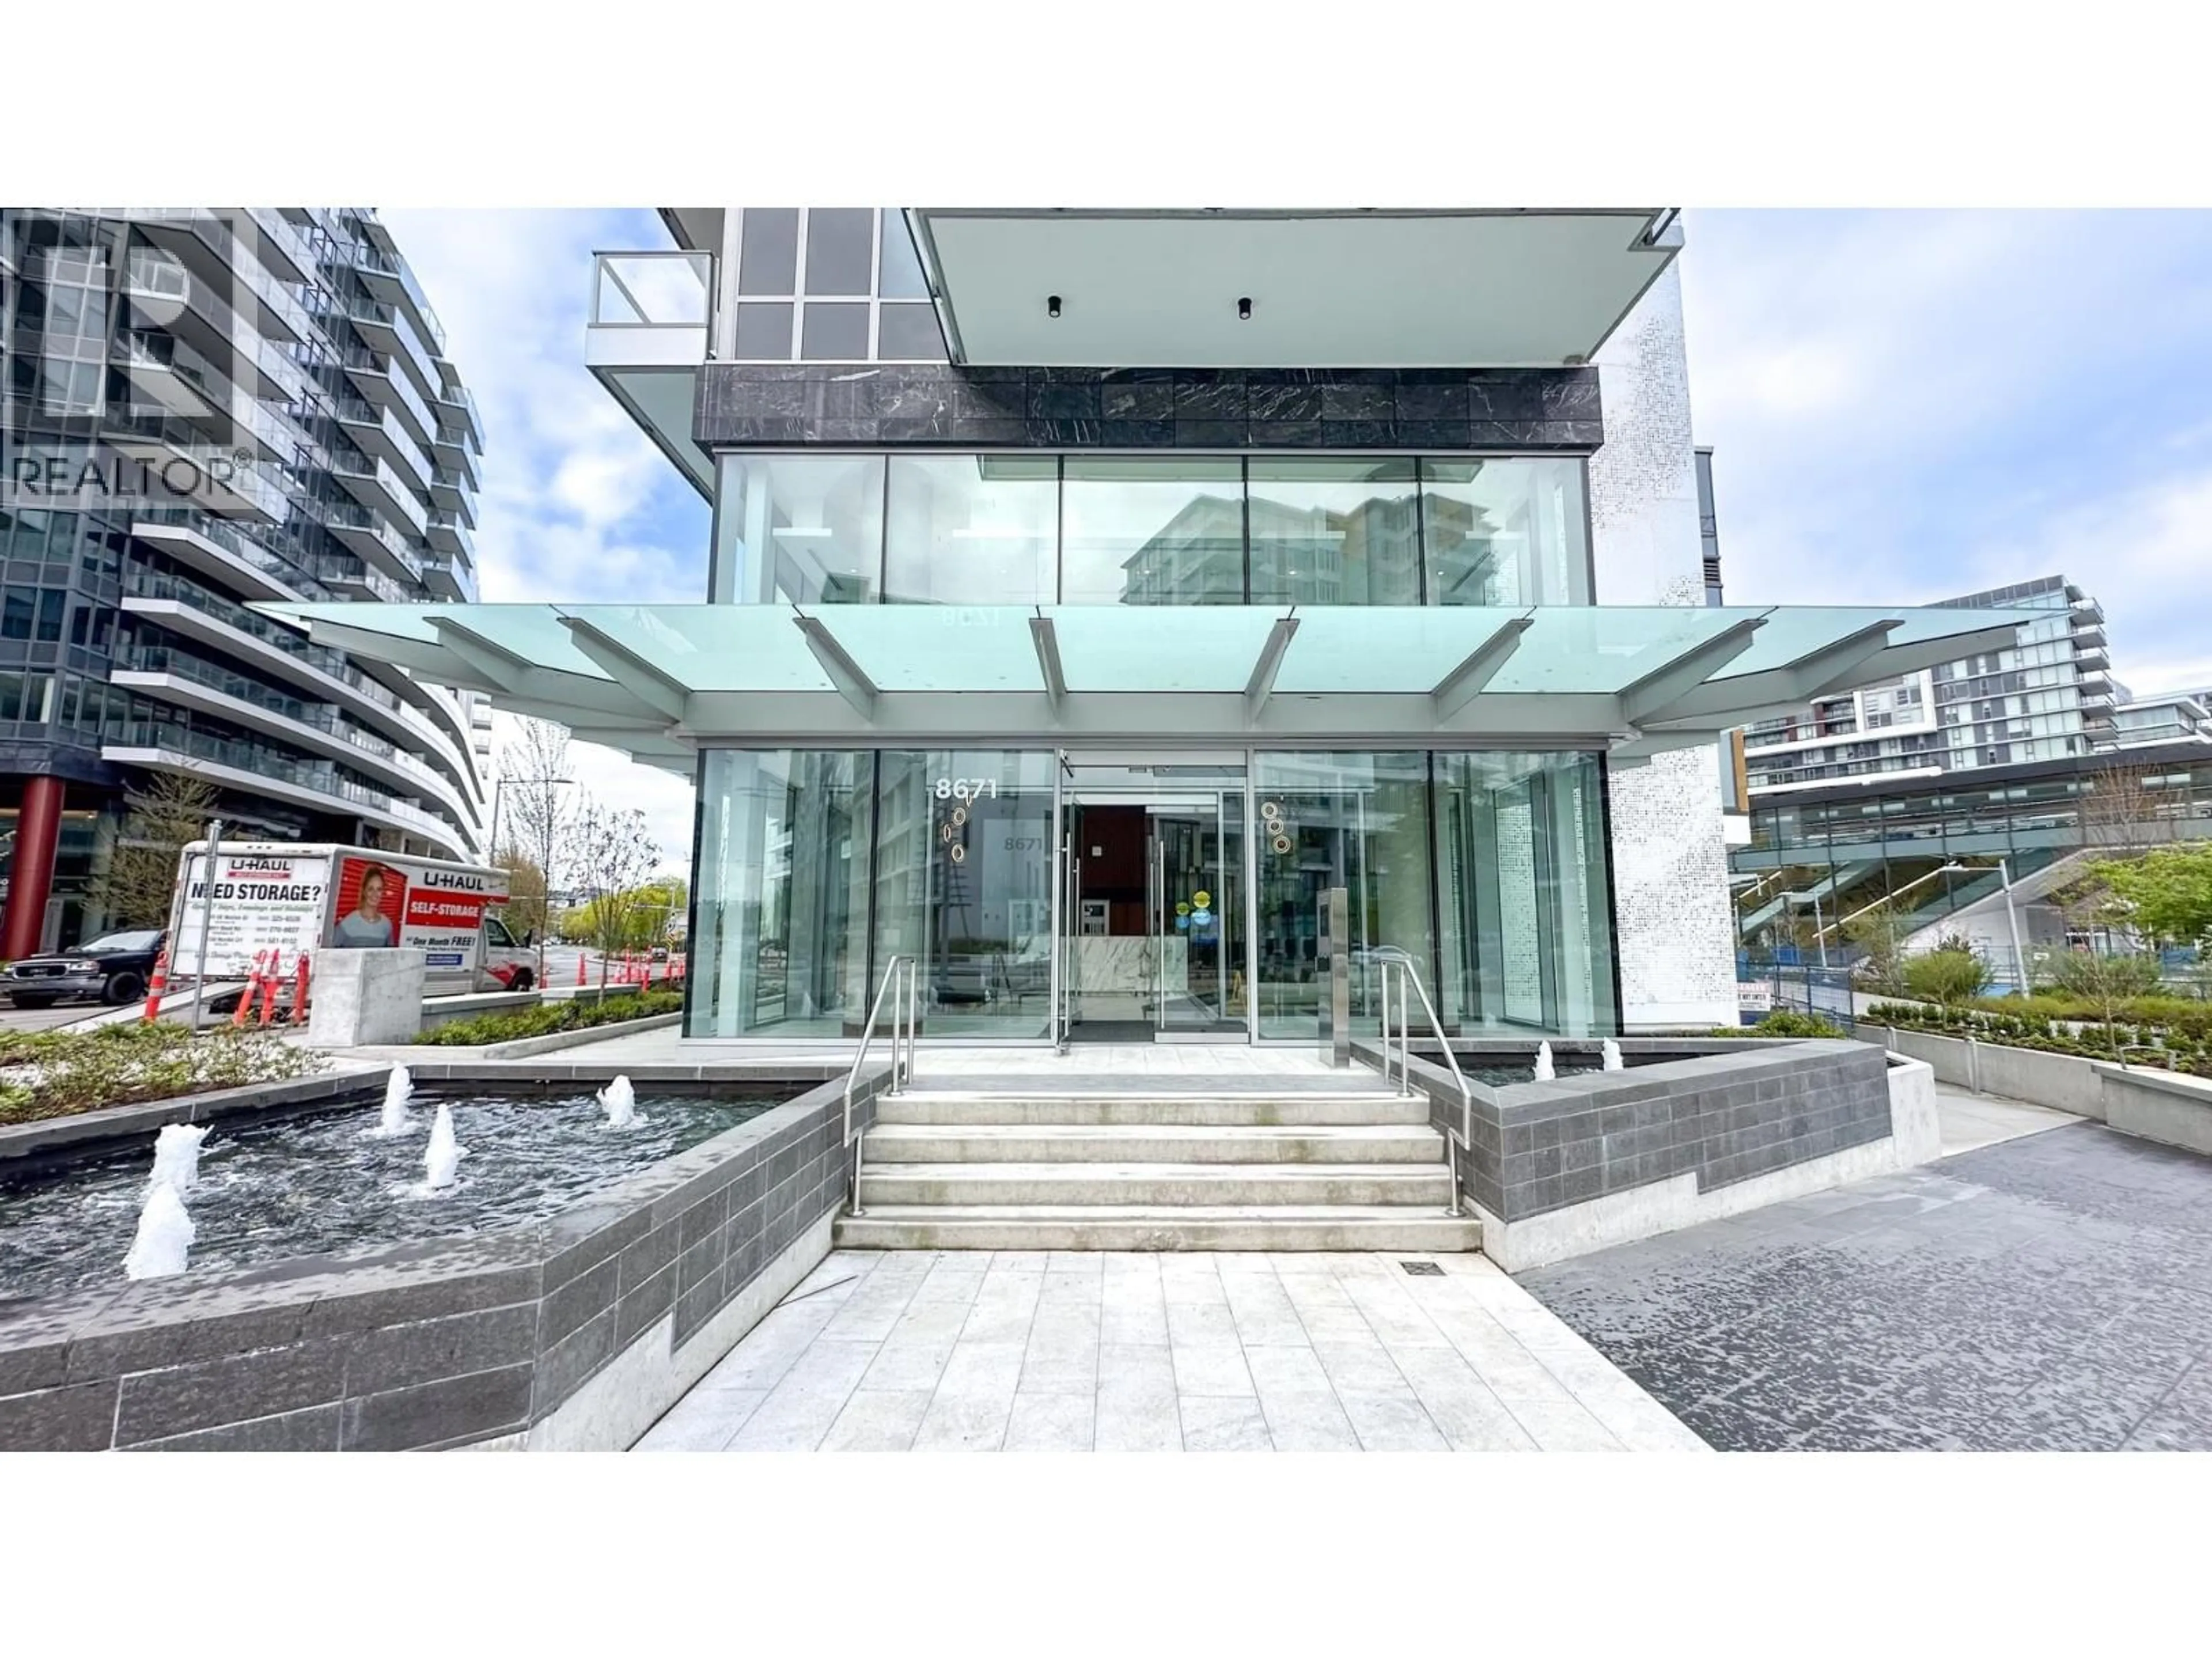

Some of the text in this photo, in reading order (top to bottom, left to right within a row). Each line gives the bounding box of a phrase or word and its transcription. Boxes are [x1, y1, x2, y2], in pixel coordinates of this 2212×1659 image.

[935, 778, 997, 799] 8671
[1004, 837, 1042, 850] 8671
[231, 860, 290, 871] U-HAUL
[424, 872, 483, 891] U-HAUL
[191, 883, 321, 902] NED STORAGE?
[411, 901, 479, 918] SELF-STORAGE
[451, 936, 476, 946] FREE!
